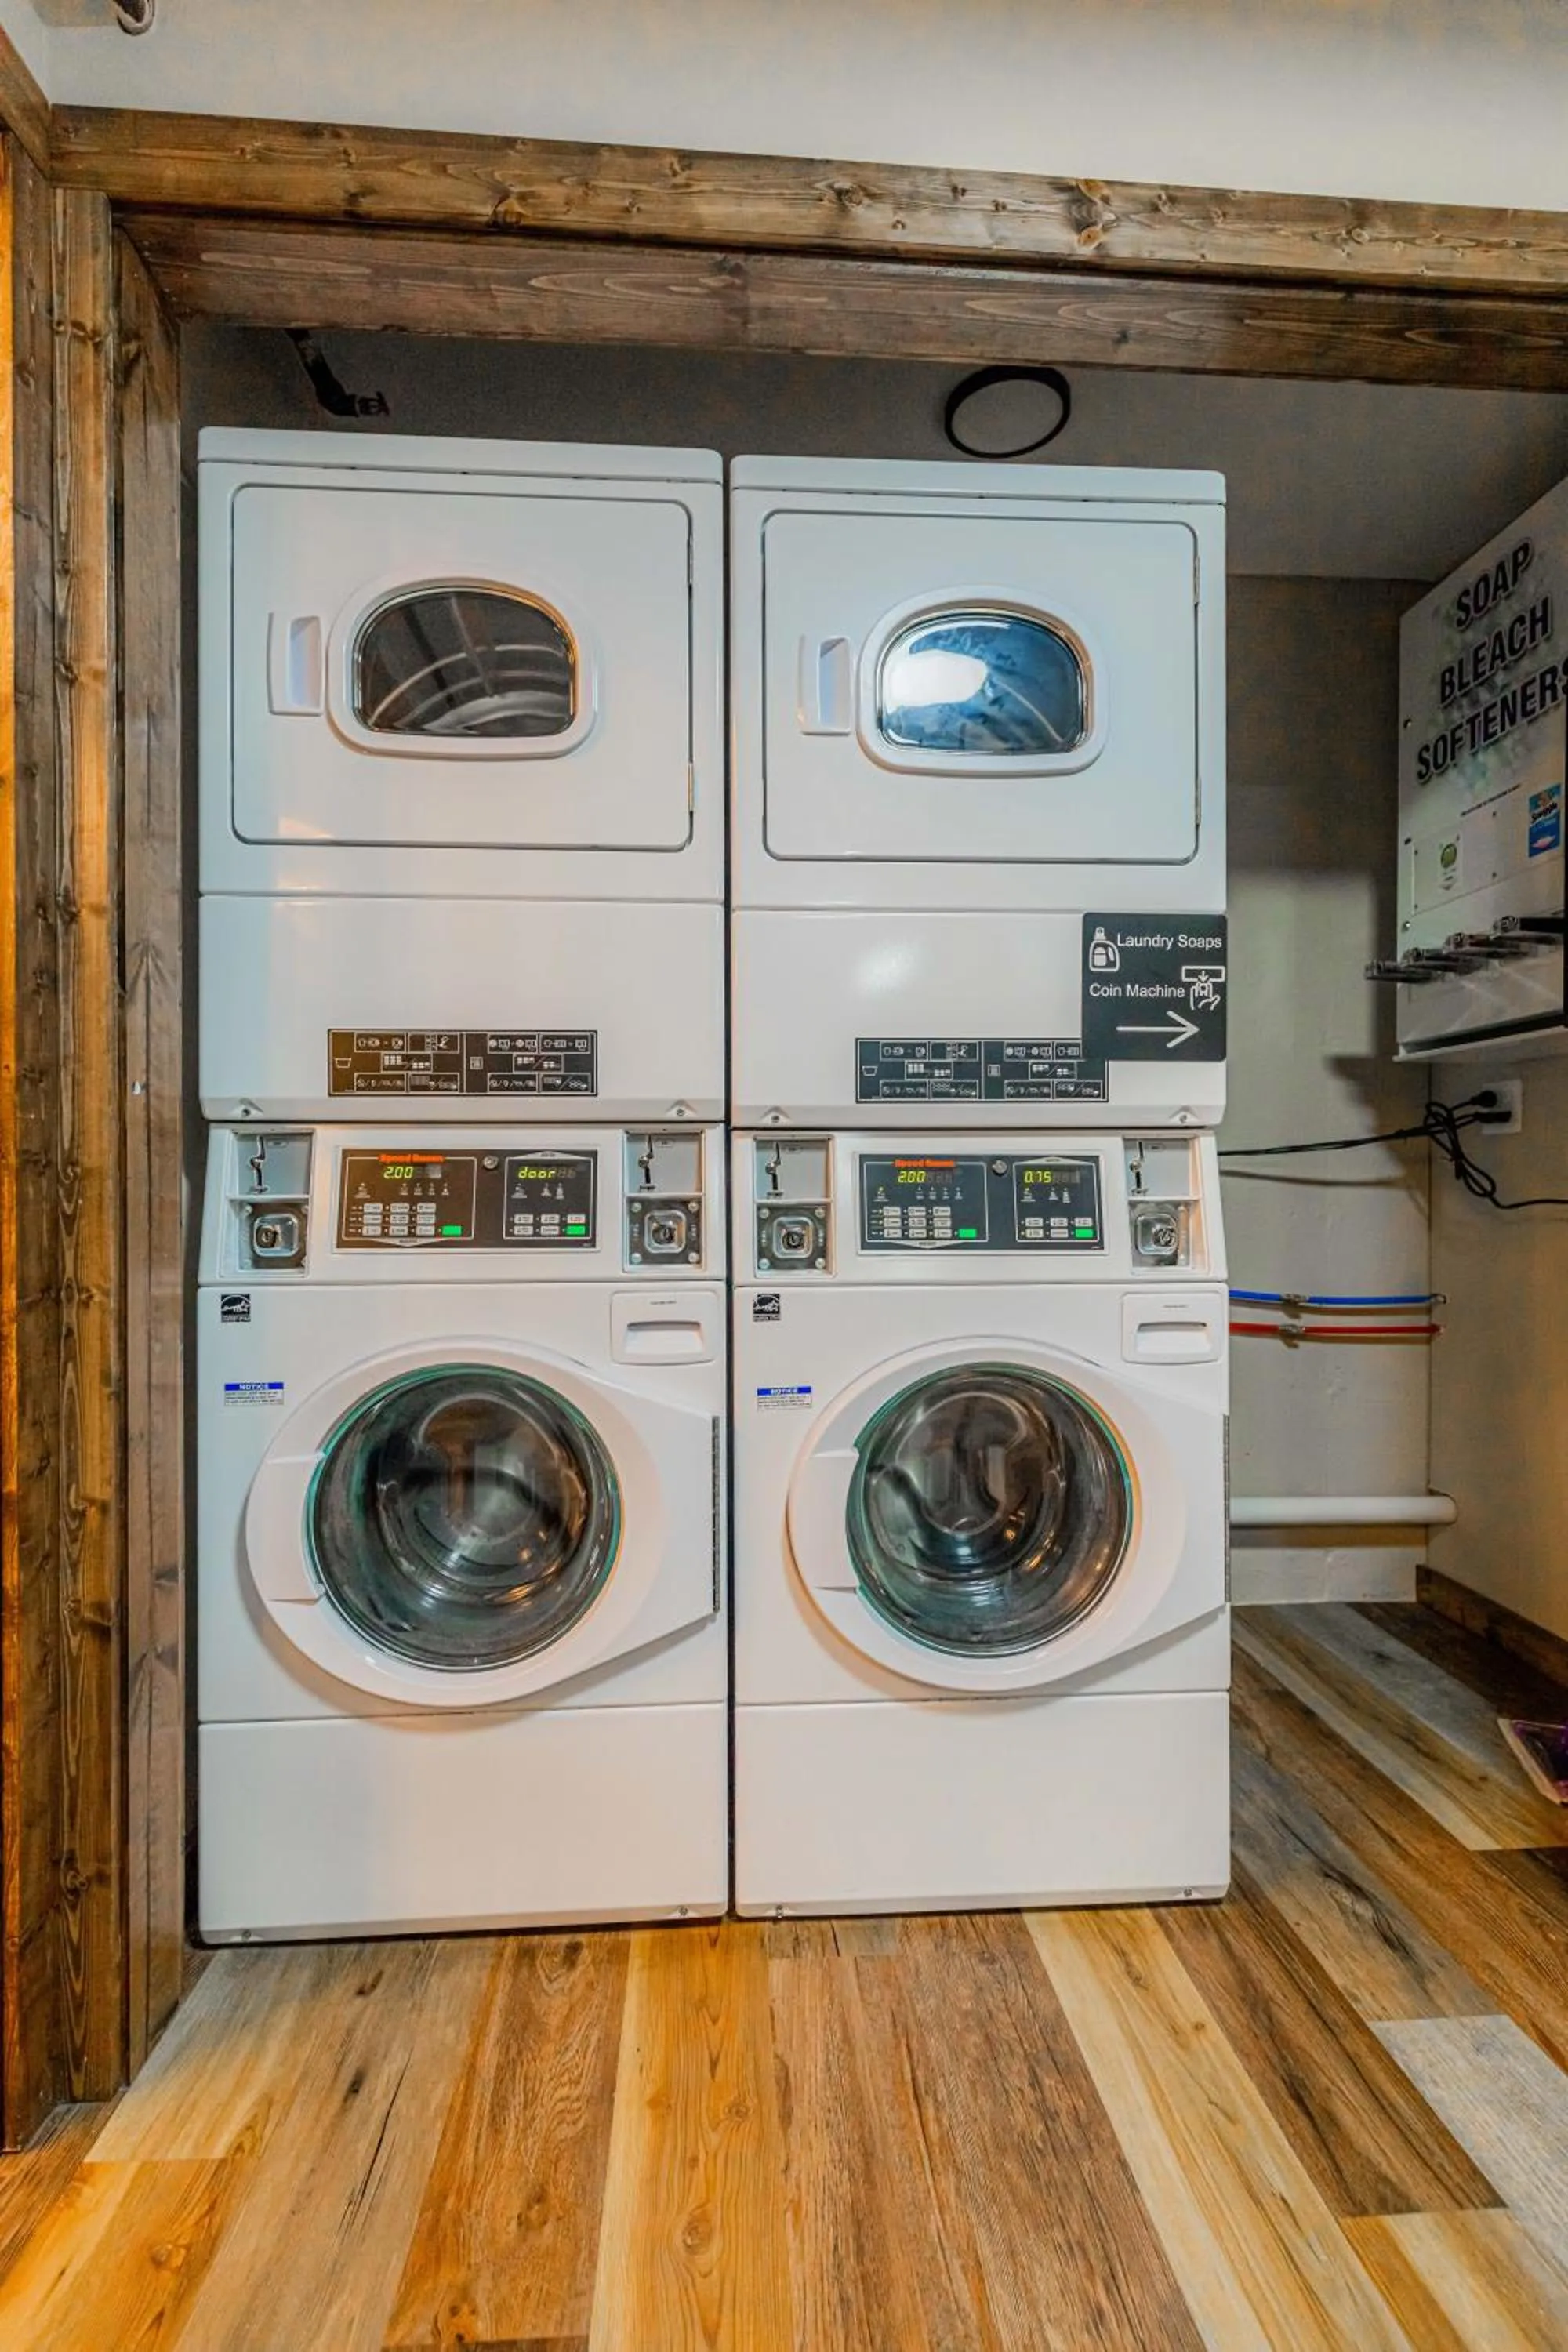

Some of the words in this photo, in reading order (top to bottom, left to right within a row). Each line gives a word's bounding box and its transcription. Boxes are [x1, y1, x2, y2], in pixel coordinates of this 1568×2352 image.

[1456, 542, 1530, 628] SOAP
[1440, 597, 1549, 705] BLEACH
[1117, 933, 1174, 950] Laundry
[1178, 934, 1222, 950] Soaps
[1089, 983, 1122, 997] Coin
[1127, 984, 1185, 998] Machine
[518, 1167, 556, 1178] door
